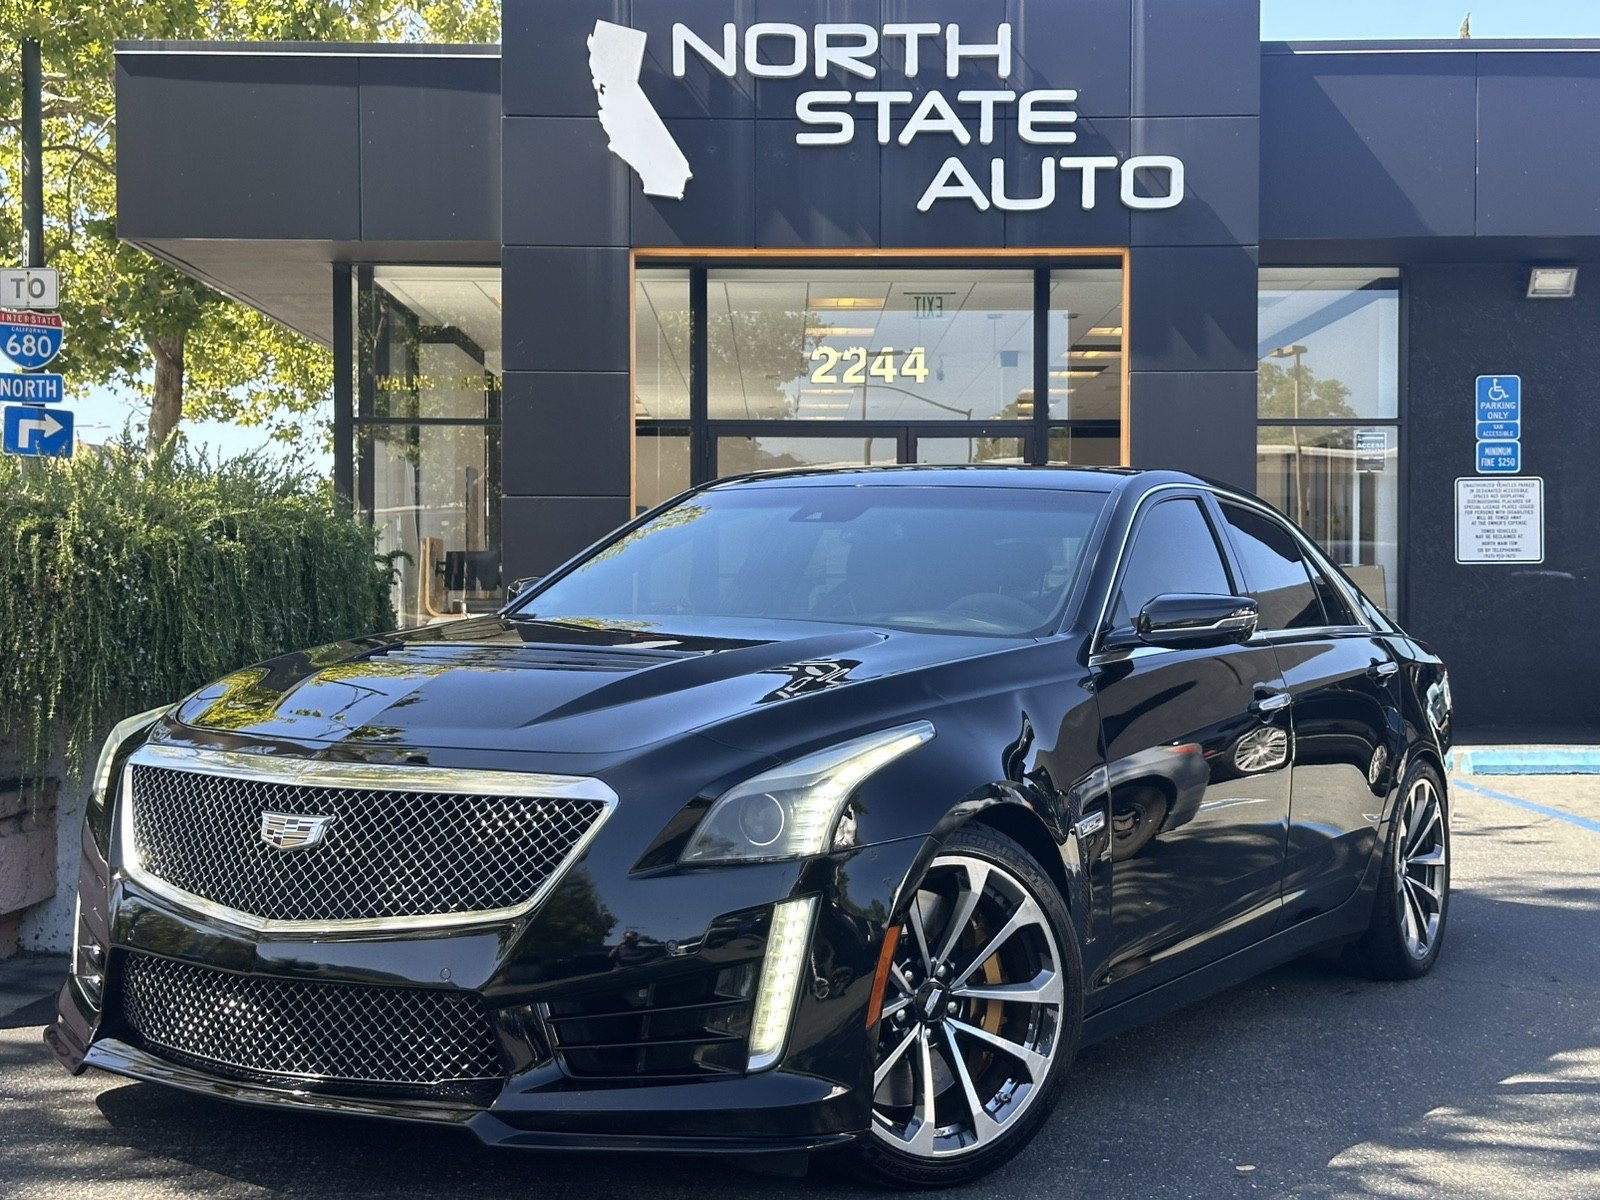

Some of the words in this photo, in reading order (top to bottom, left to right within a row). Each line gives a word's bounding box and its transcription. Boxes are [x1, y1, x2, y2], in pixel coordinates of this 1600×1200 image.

[671, 22, 1012, 80] NORTH
[795, 89, 1078, 146] STATE
[916, 155, 1185, 212] AUTO
[10, 278, 46, 299] TO
[1, 312, 57, 326] INTERSTATE
[11, 326, 48, 335] CALIFORNIA
[6, 333, 52, 358] 680
[810, 345, 929, 384] 2244
[0, 378, 57, 398] NORTH
[1480, 402, 1516, 410] PARKING
[1487, 412, 1509, 420] ONLY
[1484, 447, 1512, 456] MINIMUM
[1481, 458, 1495, 467] FINE
[1498, 458, 1516, 467] $250
